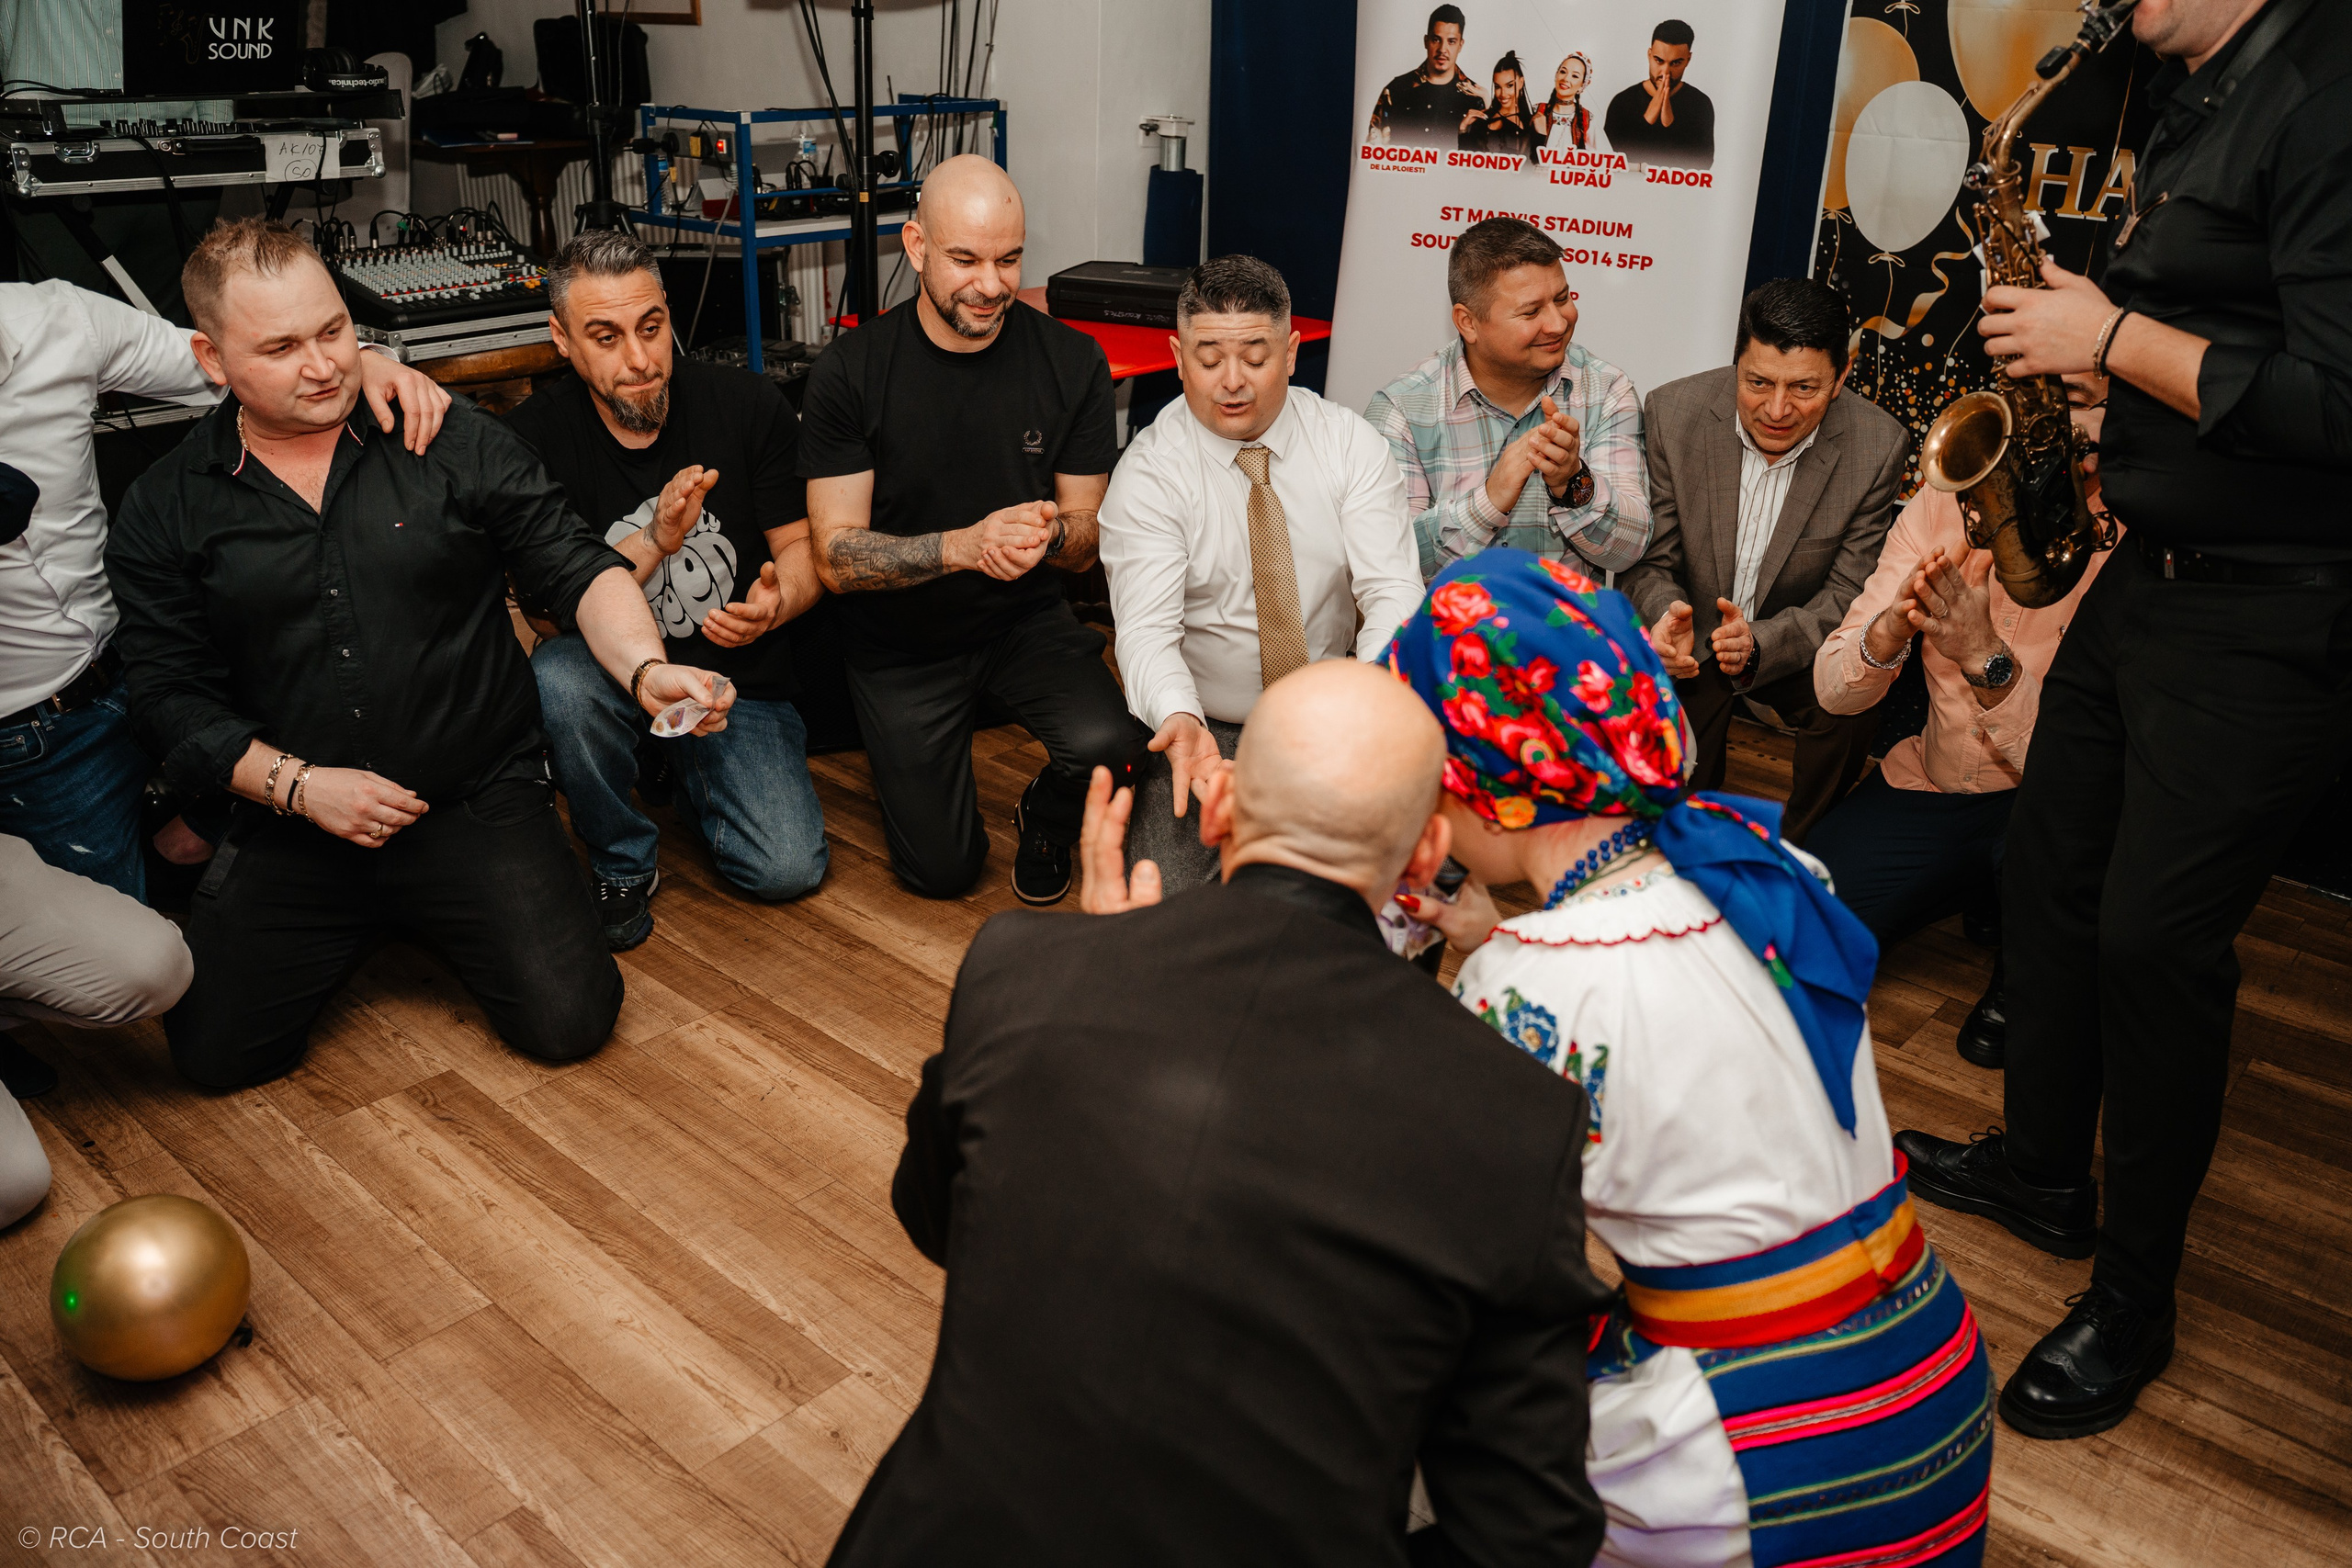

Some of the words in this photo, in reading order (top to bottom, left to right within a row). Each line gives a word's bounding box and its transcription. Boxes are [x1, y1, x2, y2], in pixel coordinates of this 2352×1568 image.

[208, 42, 272, 61] SOUND
[1361, 145, 1438, 164] BOGDAN
[1447, 152, 1523, 172] SHONDY
[1392, 165, 1425, 174] PLOIESTI
[1646, 168, 1713, 188] JADOR
[1440, 206, 1464, 222] ST
[1544, 216, 1633, 239] STADIUM
[1562, 247, 1612, 267] SO14
[1616, 253, 1653, 271] 5FP
